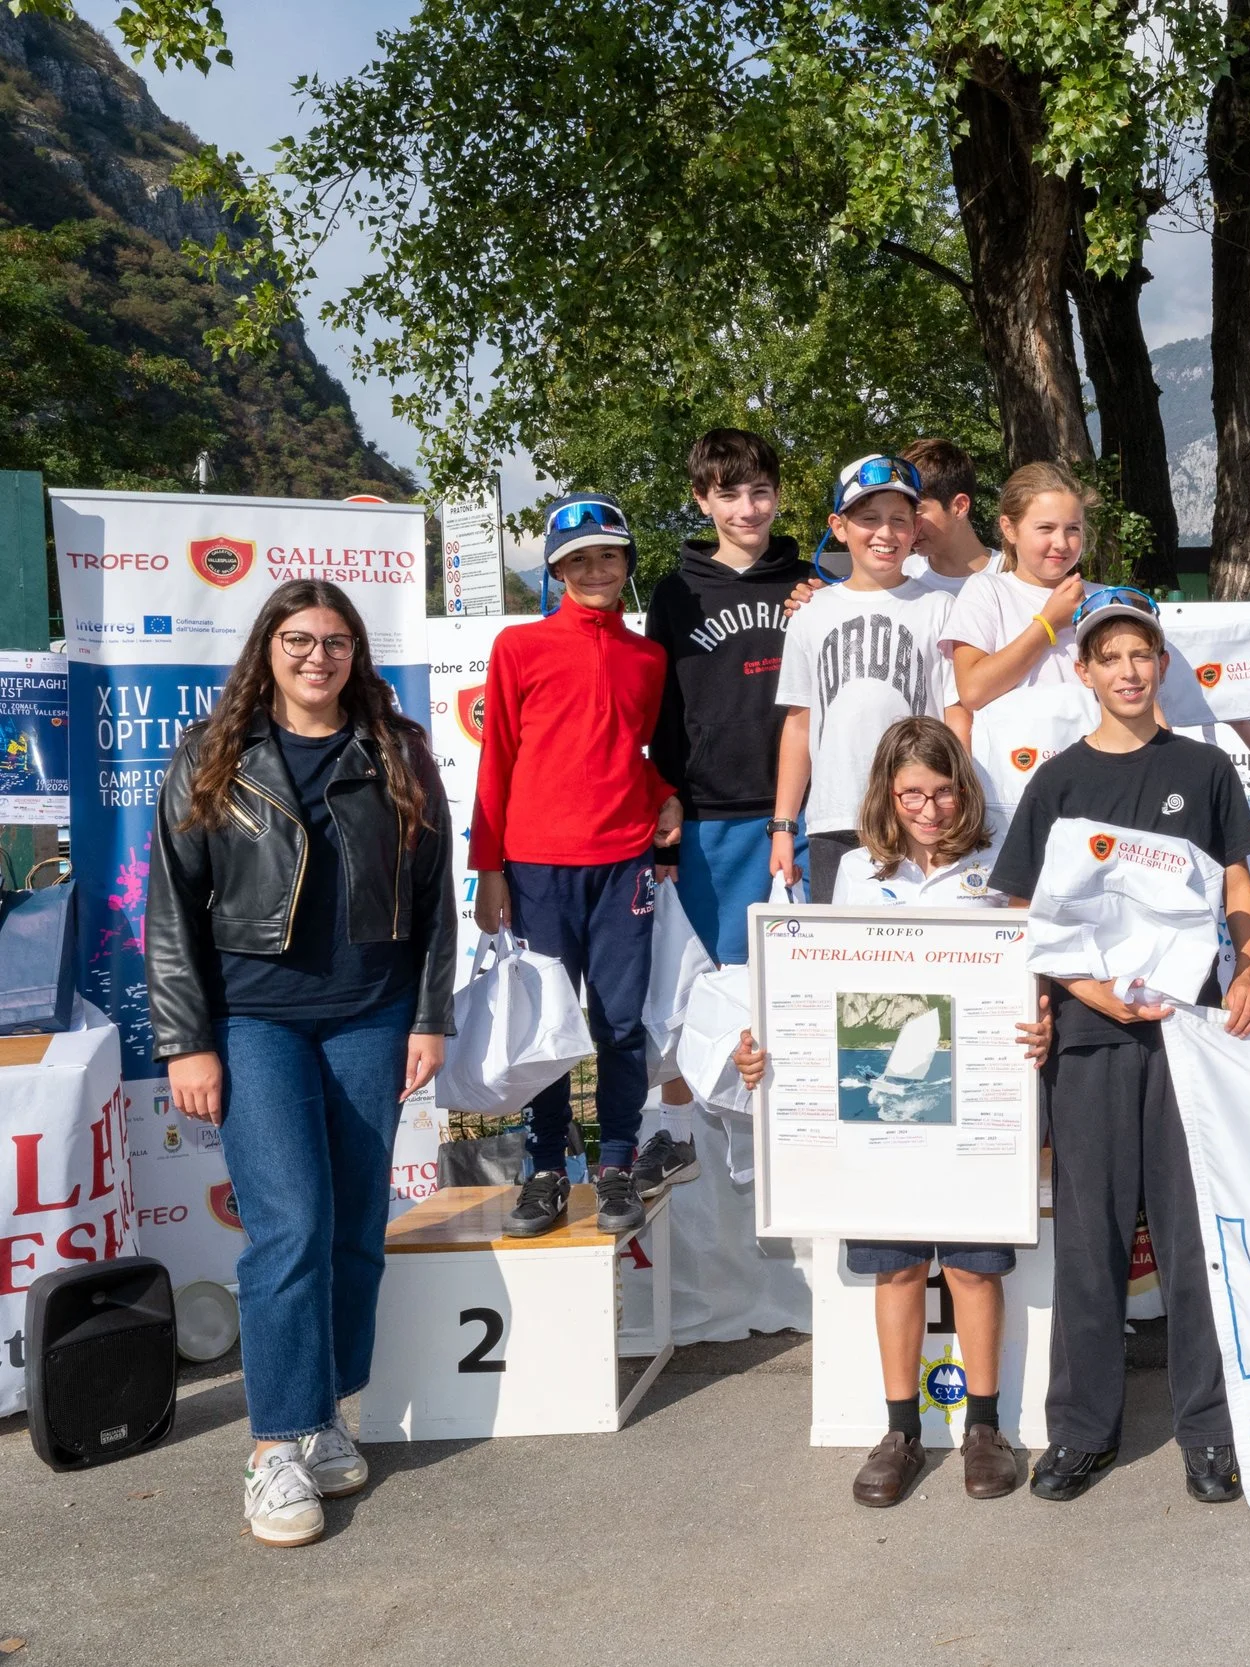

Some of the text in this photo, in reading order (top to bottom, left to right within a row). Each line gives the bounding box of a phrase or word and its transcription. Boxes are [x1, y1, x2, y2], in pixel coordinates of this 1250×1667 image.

[66, 552, 169, 571] TROFEO
[266, 547, 415, 568] GALLETTO
[268, 567, 416, 584] VALLESPLUGA
[76, 618, 135, 634] Interreg
[176, 618, 214, 626] Cofinanziato
[97, 685, 152, 716] XIV
[98, 718, 200, 750] OPTIM
[46, 783, 69, 791] 2026
[99, 788, 158, 807] TROFE
[1119, 842, 1187, 867] GALLETTO
[866, 926, 924, 937] TROFEO
[995, 930, 1016, 940] FIV
[790, 948, 1004, 965] INTERLAGHINA OPTIMIST
[457, 1307, 507, 1374] 2
[935, 1387, 961, 1395] CVT
